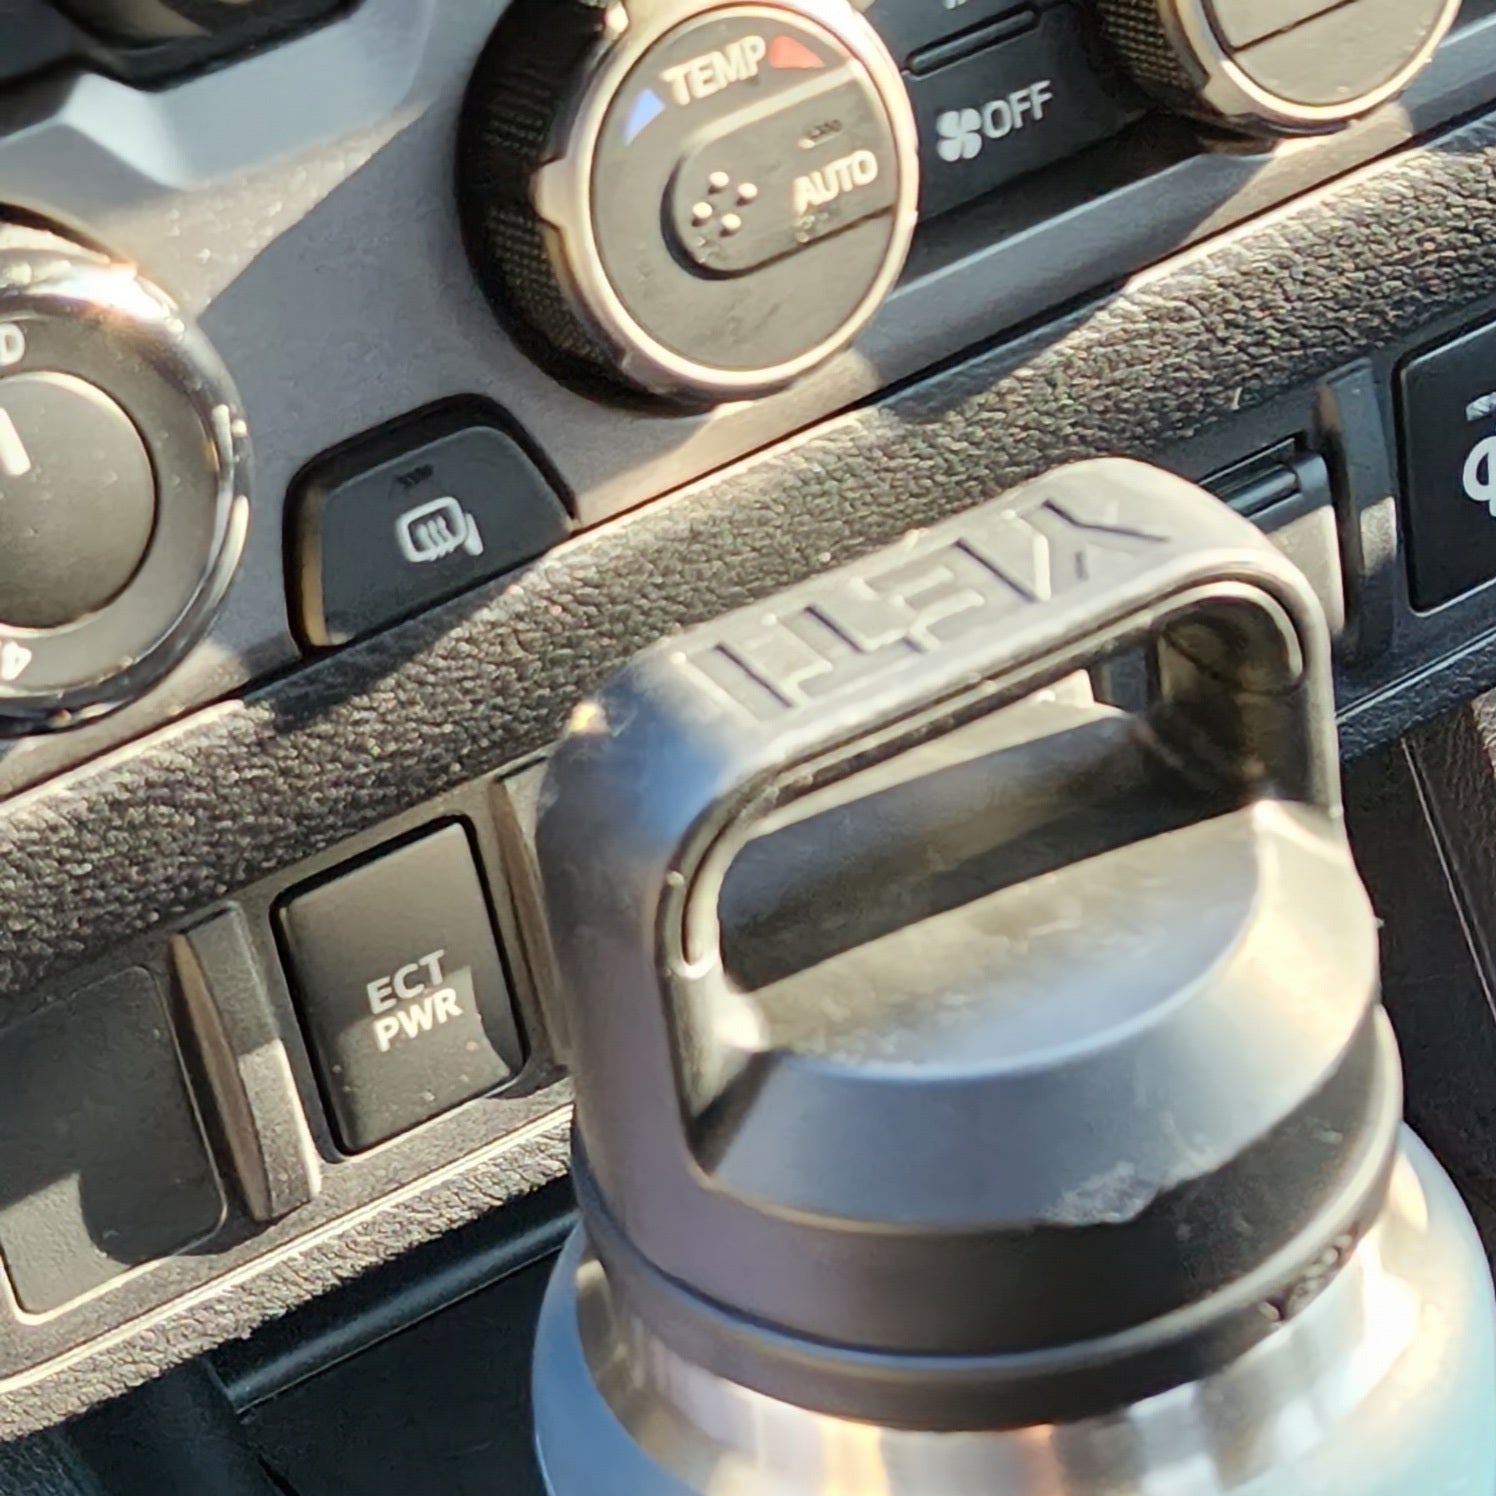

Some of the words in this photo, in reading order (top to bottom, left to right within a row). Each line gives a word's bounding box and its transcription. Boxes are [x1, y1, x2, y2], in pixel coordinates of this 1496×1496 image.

[661, 35, 767, 106] TEMP
[981, 80, 1053, 139] OFF
[792, 150, 879, 215] AUTO
[366, 948, 445, 1015] ECT
[373, 987, 464, 1053] PWR
